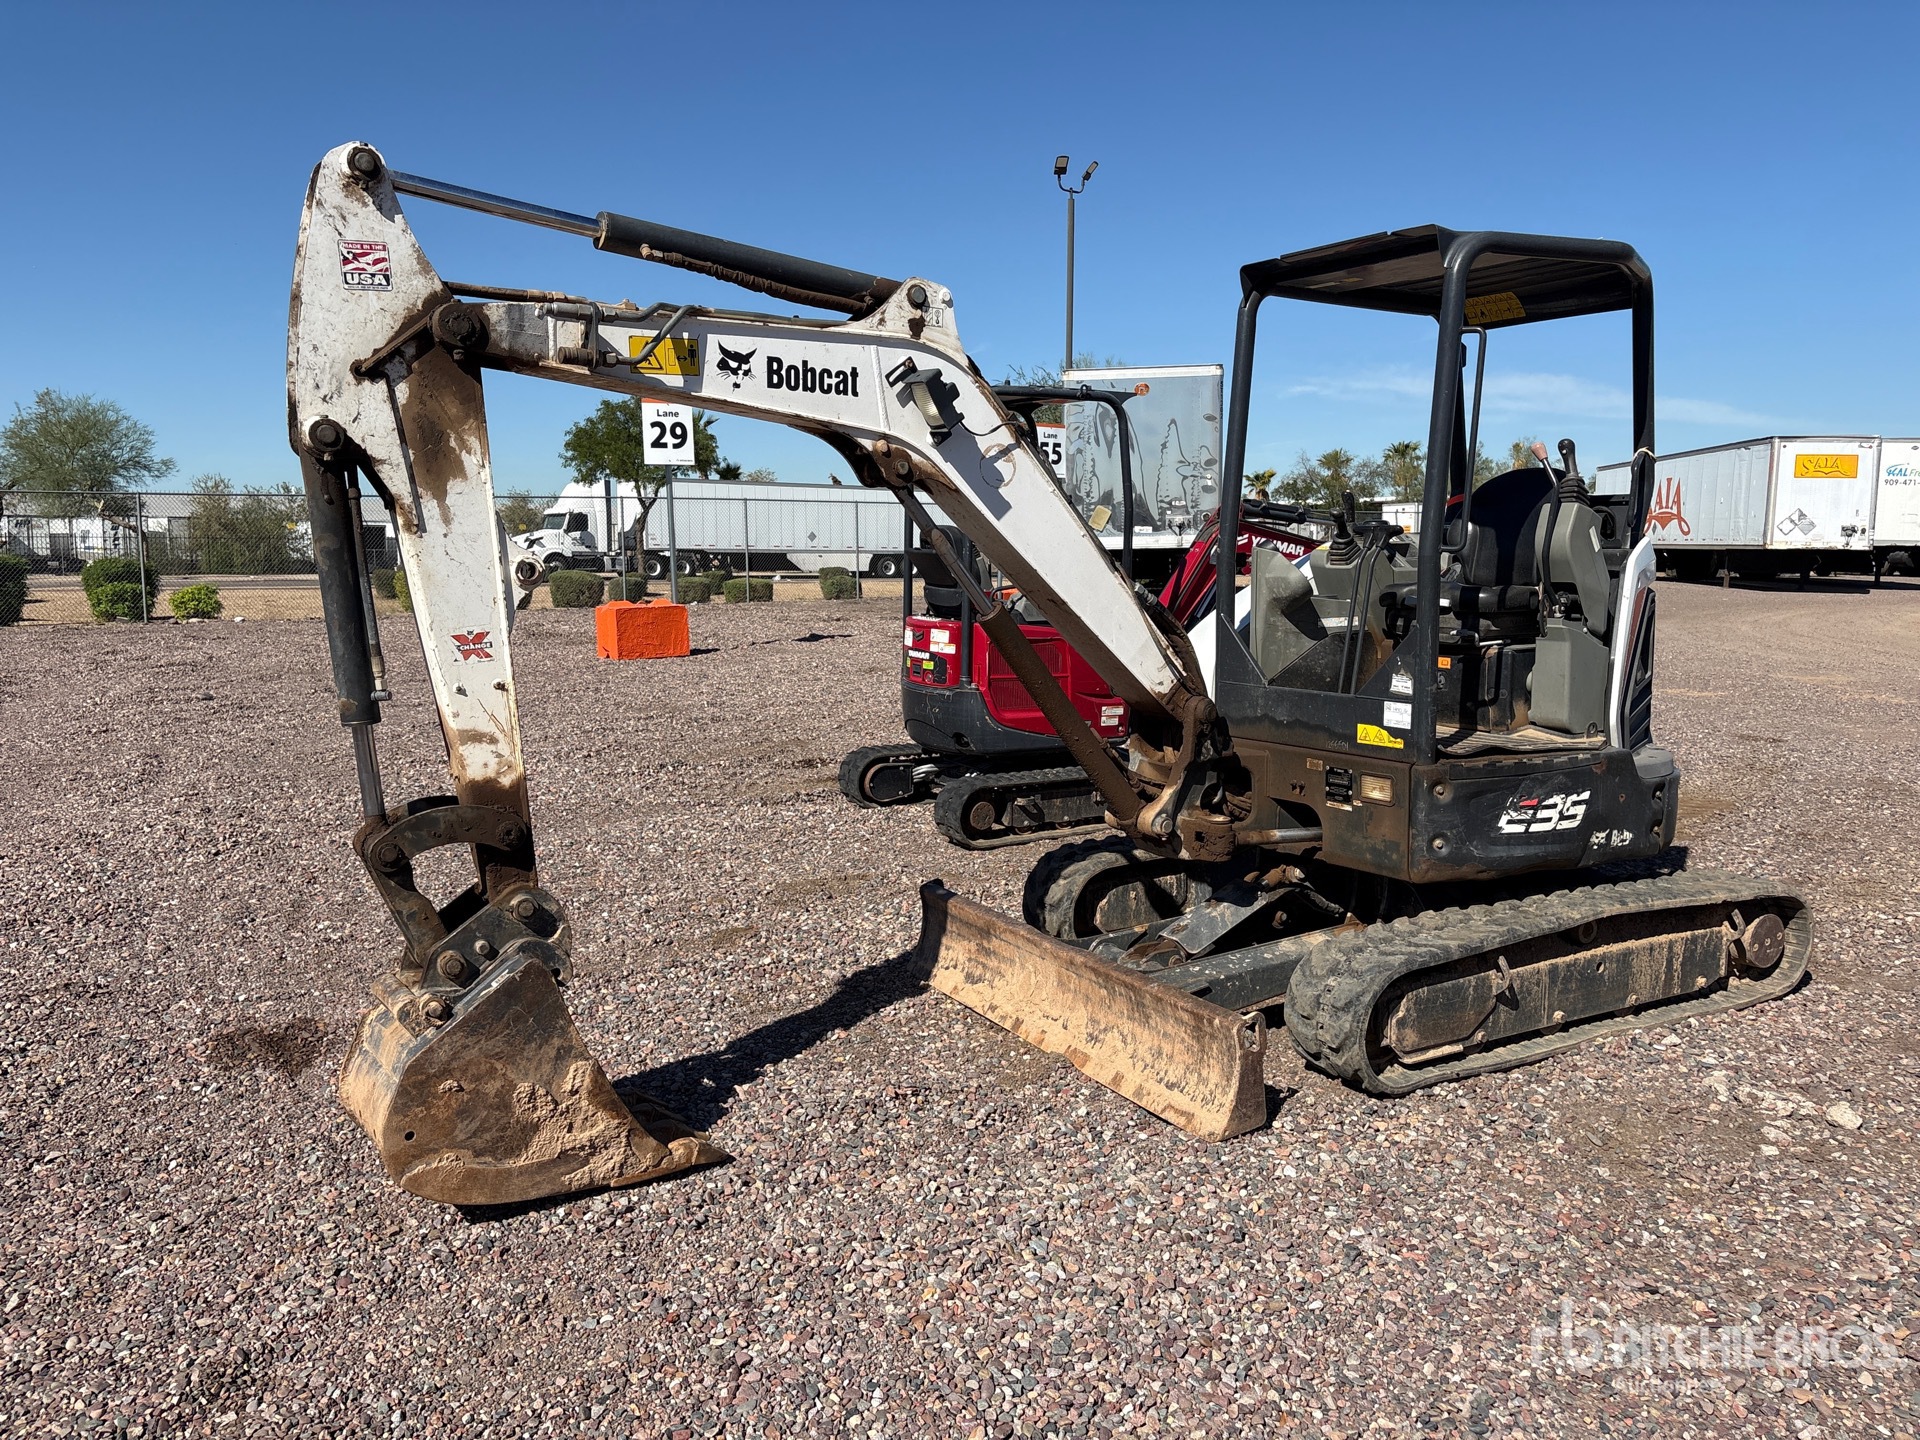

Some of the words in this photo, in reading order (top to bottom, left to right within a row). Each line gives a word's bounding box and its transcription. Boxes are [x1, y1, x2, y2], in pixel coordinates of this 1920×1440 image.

[345, 272, 388, 286] USA
[766, 356, 859, 398] Bobcat
[656, 409, 680, 418] Lane
[650, 421, 688, 449] 29
[1801, 457, 1851, 477] SAIA
[1644, 477, 1691, 536] AIA
[1498, 790, 1591, 834] E35
